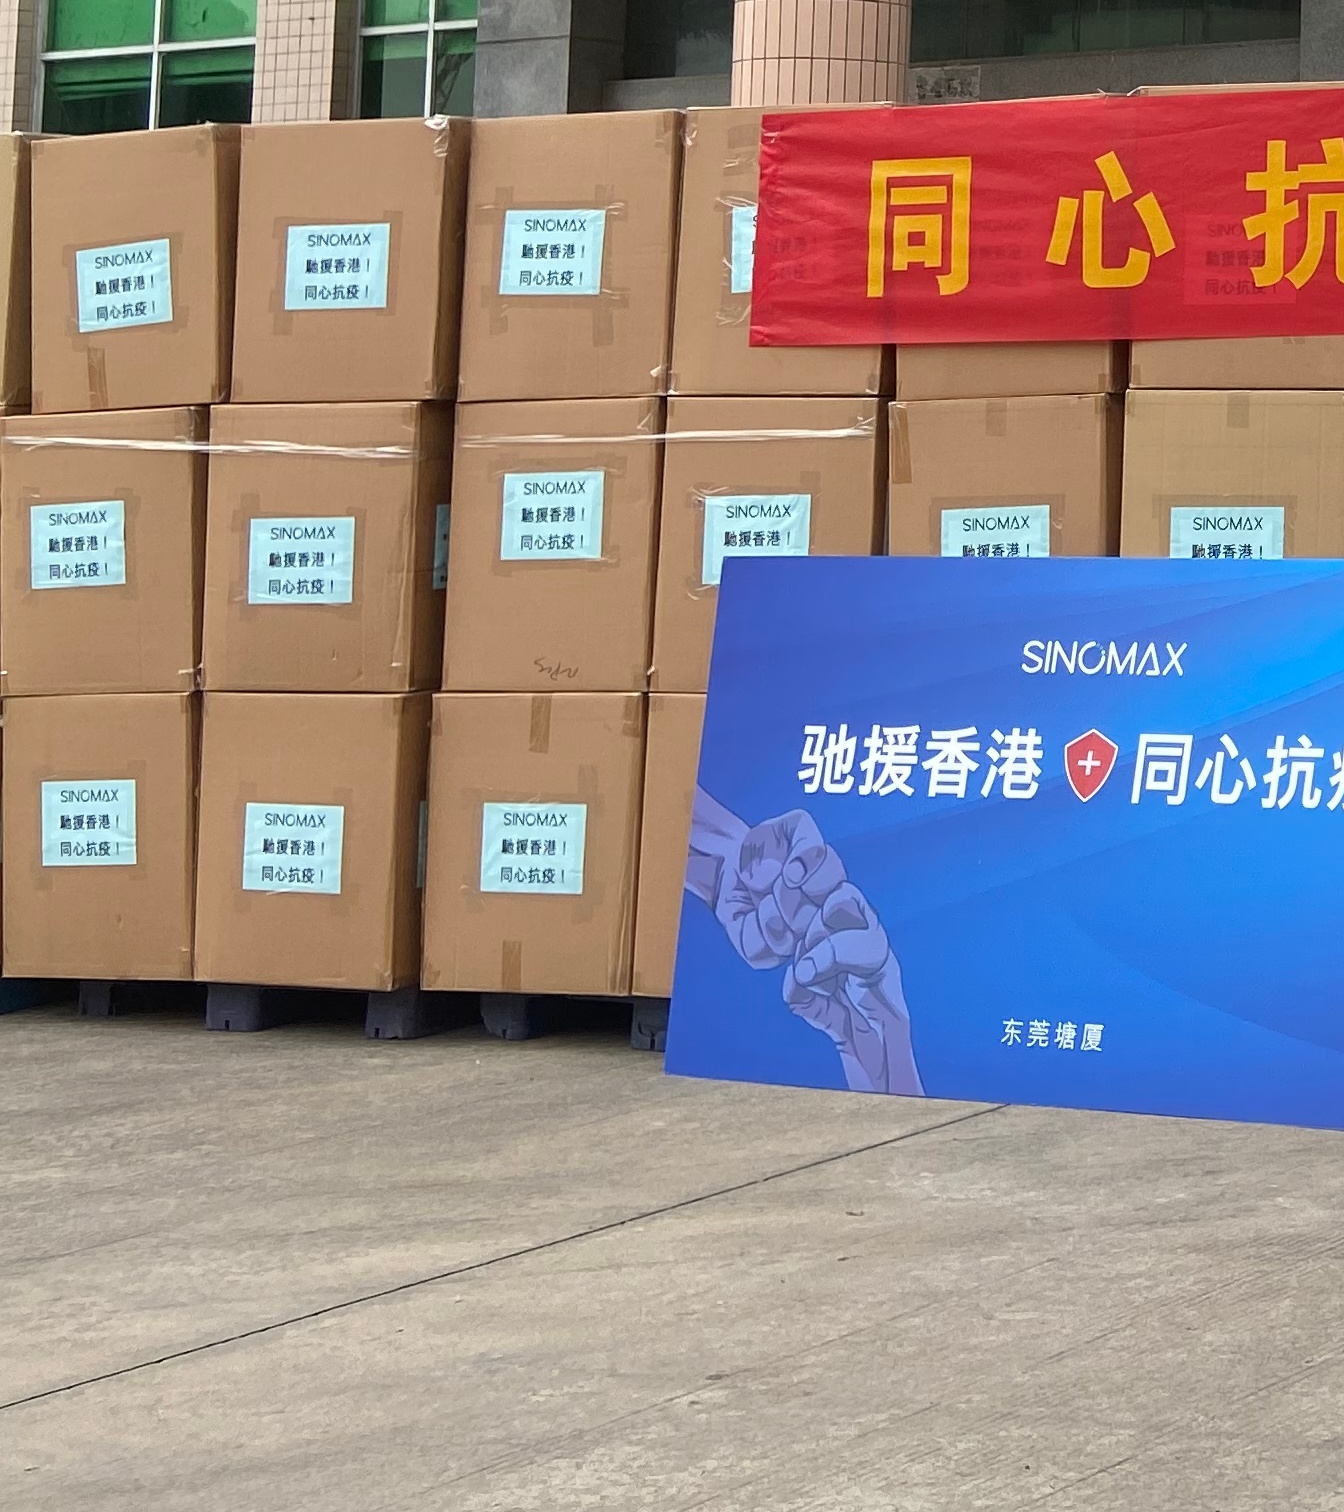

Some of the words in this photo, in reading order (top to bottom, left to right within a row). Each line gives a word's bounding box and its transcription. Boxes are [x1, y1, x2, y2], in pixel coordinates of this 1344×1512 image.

[525, 219, 586, 232] SINOMAX
[308, 233, 371, 247] SINOMAX
[95, 250, 152, 269] SINOMAX
[524, 480, 585, 495] SINOMAX
[49, 510, 107, 526] SINOMAX
[726, 505, 791, 518] SINOMAX
[963, 516, 1029, 531] SINOMAX
[1193, 517, 1263, 530] SINOMAX
[271, 527, 335, 540] SINOMAX
[1021, 640, 1189, 677] SINOMAX
[797, 723, 1044, 800] 驰援香港
[61, 789, 118, 802] SINOMAX
[265, 813, 325, 828] SINOMAX
[504, 813, 567, 827] SINOMAX
[1000, 1018, 1105, 1052] 东莞塘厦
